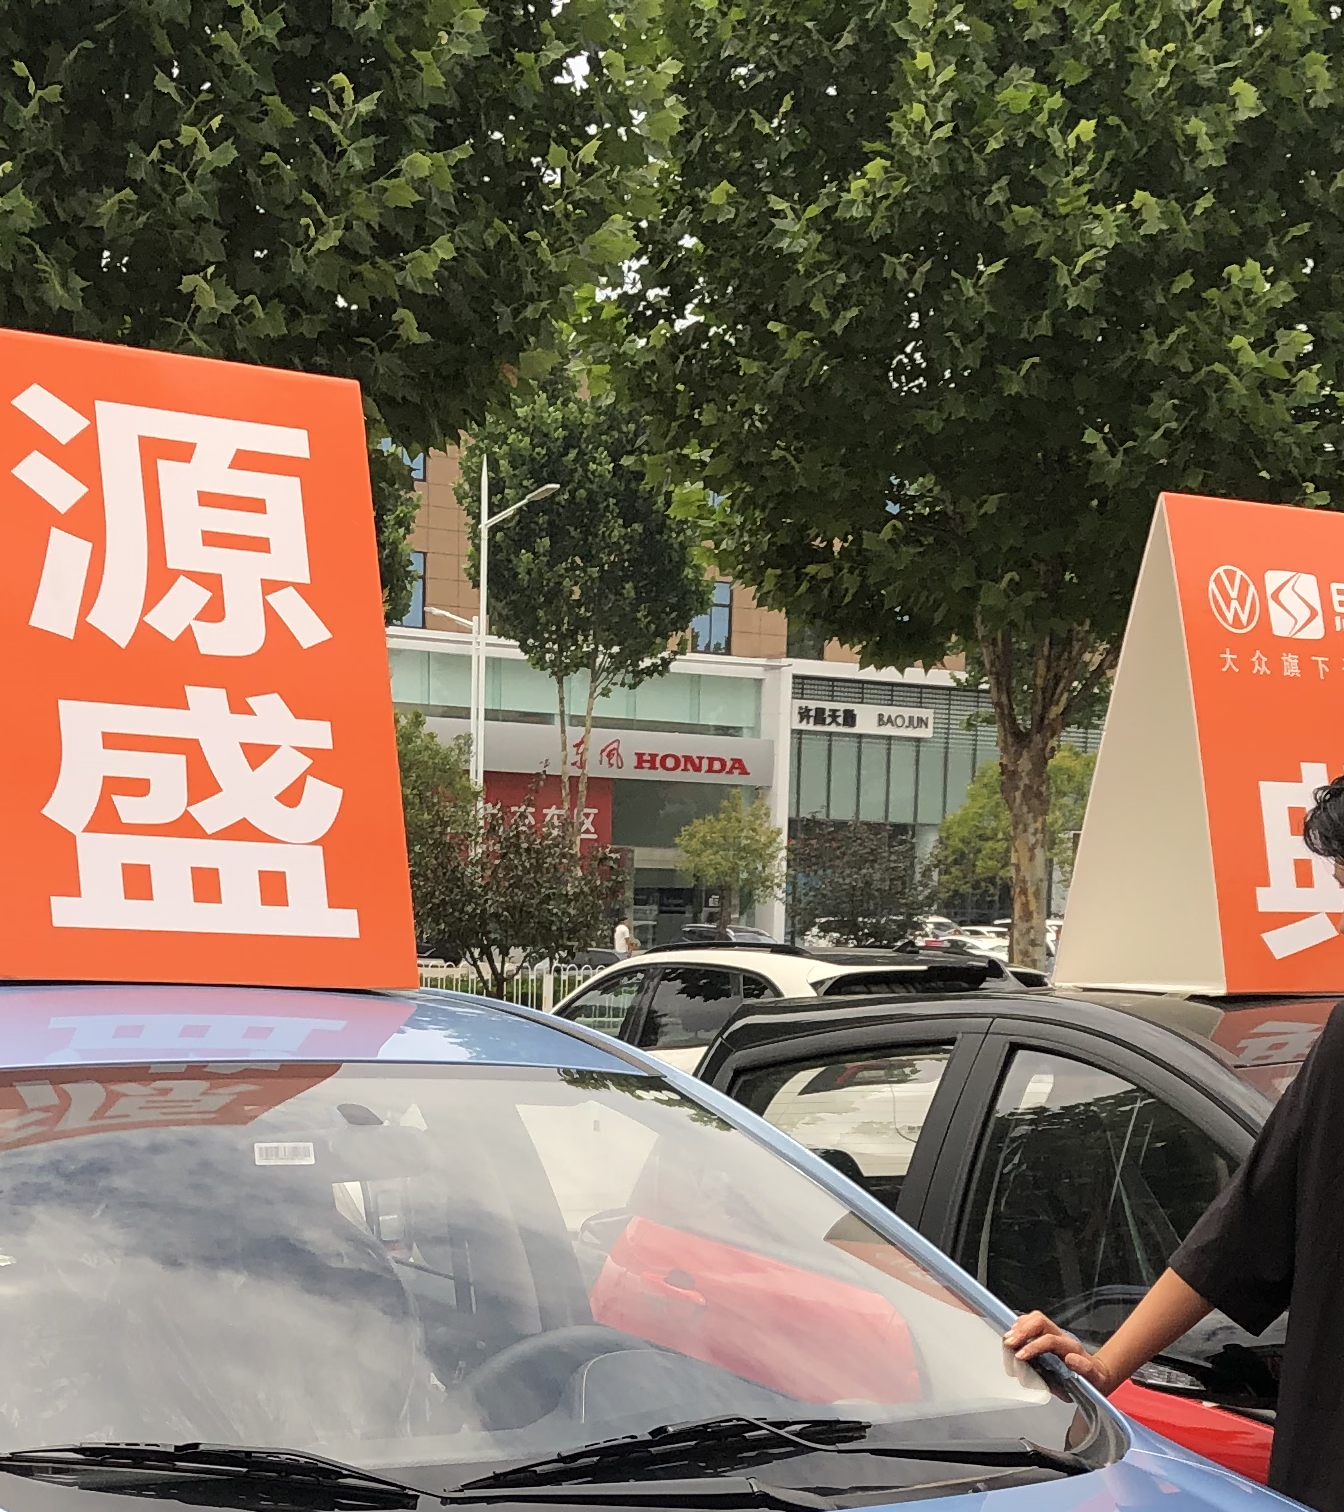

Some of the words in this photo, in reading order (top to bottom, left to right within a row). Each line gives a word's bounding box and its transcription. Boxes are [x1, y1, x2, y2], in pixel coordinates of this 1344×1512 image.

[11, 383, 360, 939] 源盛
[877, 713, 929, 729] BAOJUN
[634, 752, 751, 776] HONDA
